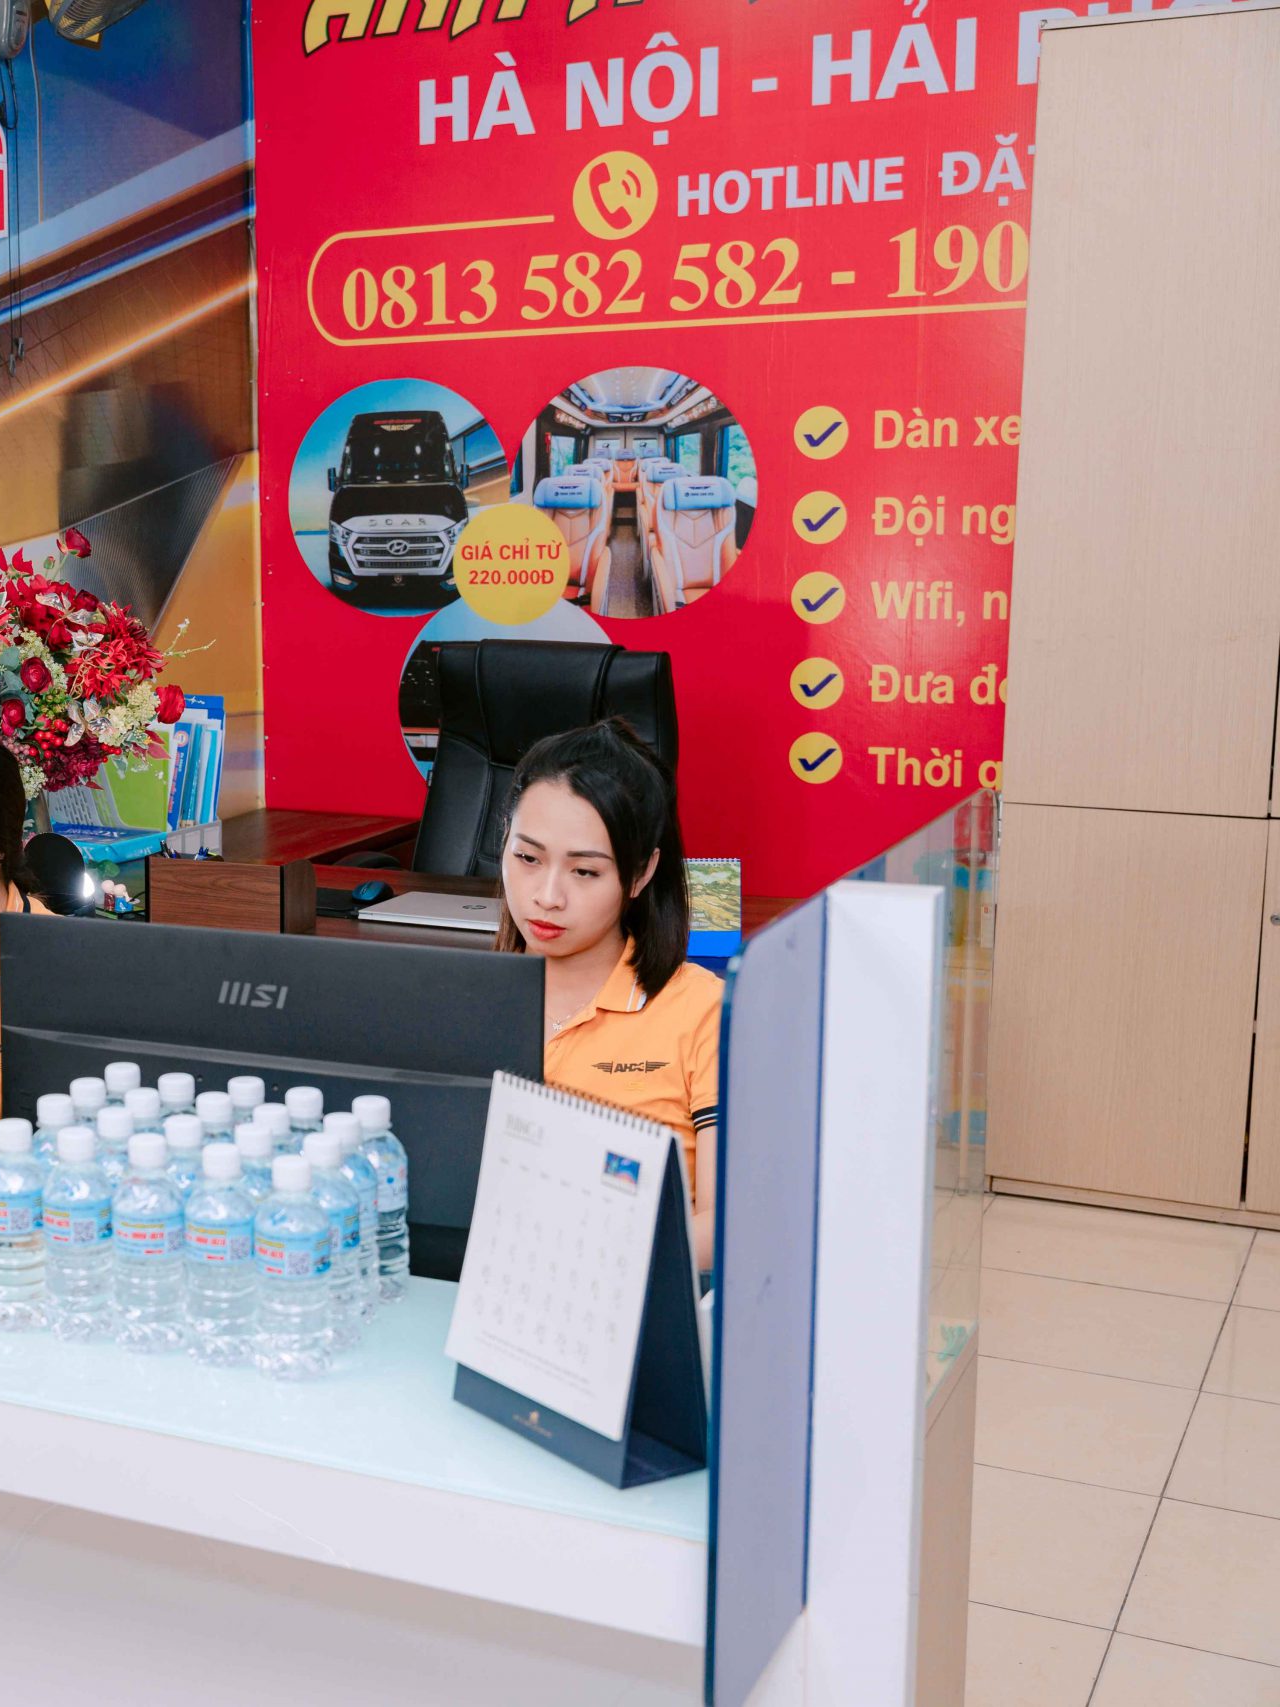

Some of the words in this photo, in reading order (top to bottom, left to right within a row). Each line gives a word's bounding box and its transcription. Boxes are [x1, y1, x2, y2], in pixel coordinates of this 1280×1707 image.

[419, 51, 536, 145] HÀ
[566, 32, 719, 145] NỘI
[751, 77, 778, 93] -
[811, 0, 977, 106] HẢI
[677, 156, 904, 217] HOTLINE
[938, 133, 1036, 206] ĐẶ
[342, 260, 497, 331] 0813
[520, 249, 645, 321] 582
[669, 238, 803, 312] 582
[831, 271, 856, 285] -
[874, 407, 958, 449] Dàn
[973, 415, 1021, 446] xe
[871, 494, 945, 547] Đội
[461, 541, 493, 560] GIÁ
[498, 538, 530, 560] CHỈ
[536, 540, 562, 560] TỪ
[469, 569, 555, 585] 220.000Đ
[871, 581, 966, 627] Wifi,
[868, 664, 955, 704] Đưa
[868, 746, 963, 788] Thời
[218, 980, 288, 1009] MSI
